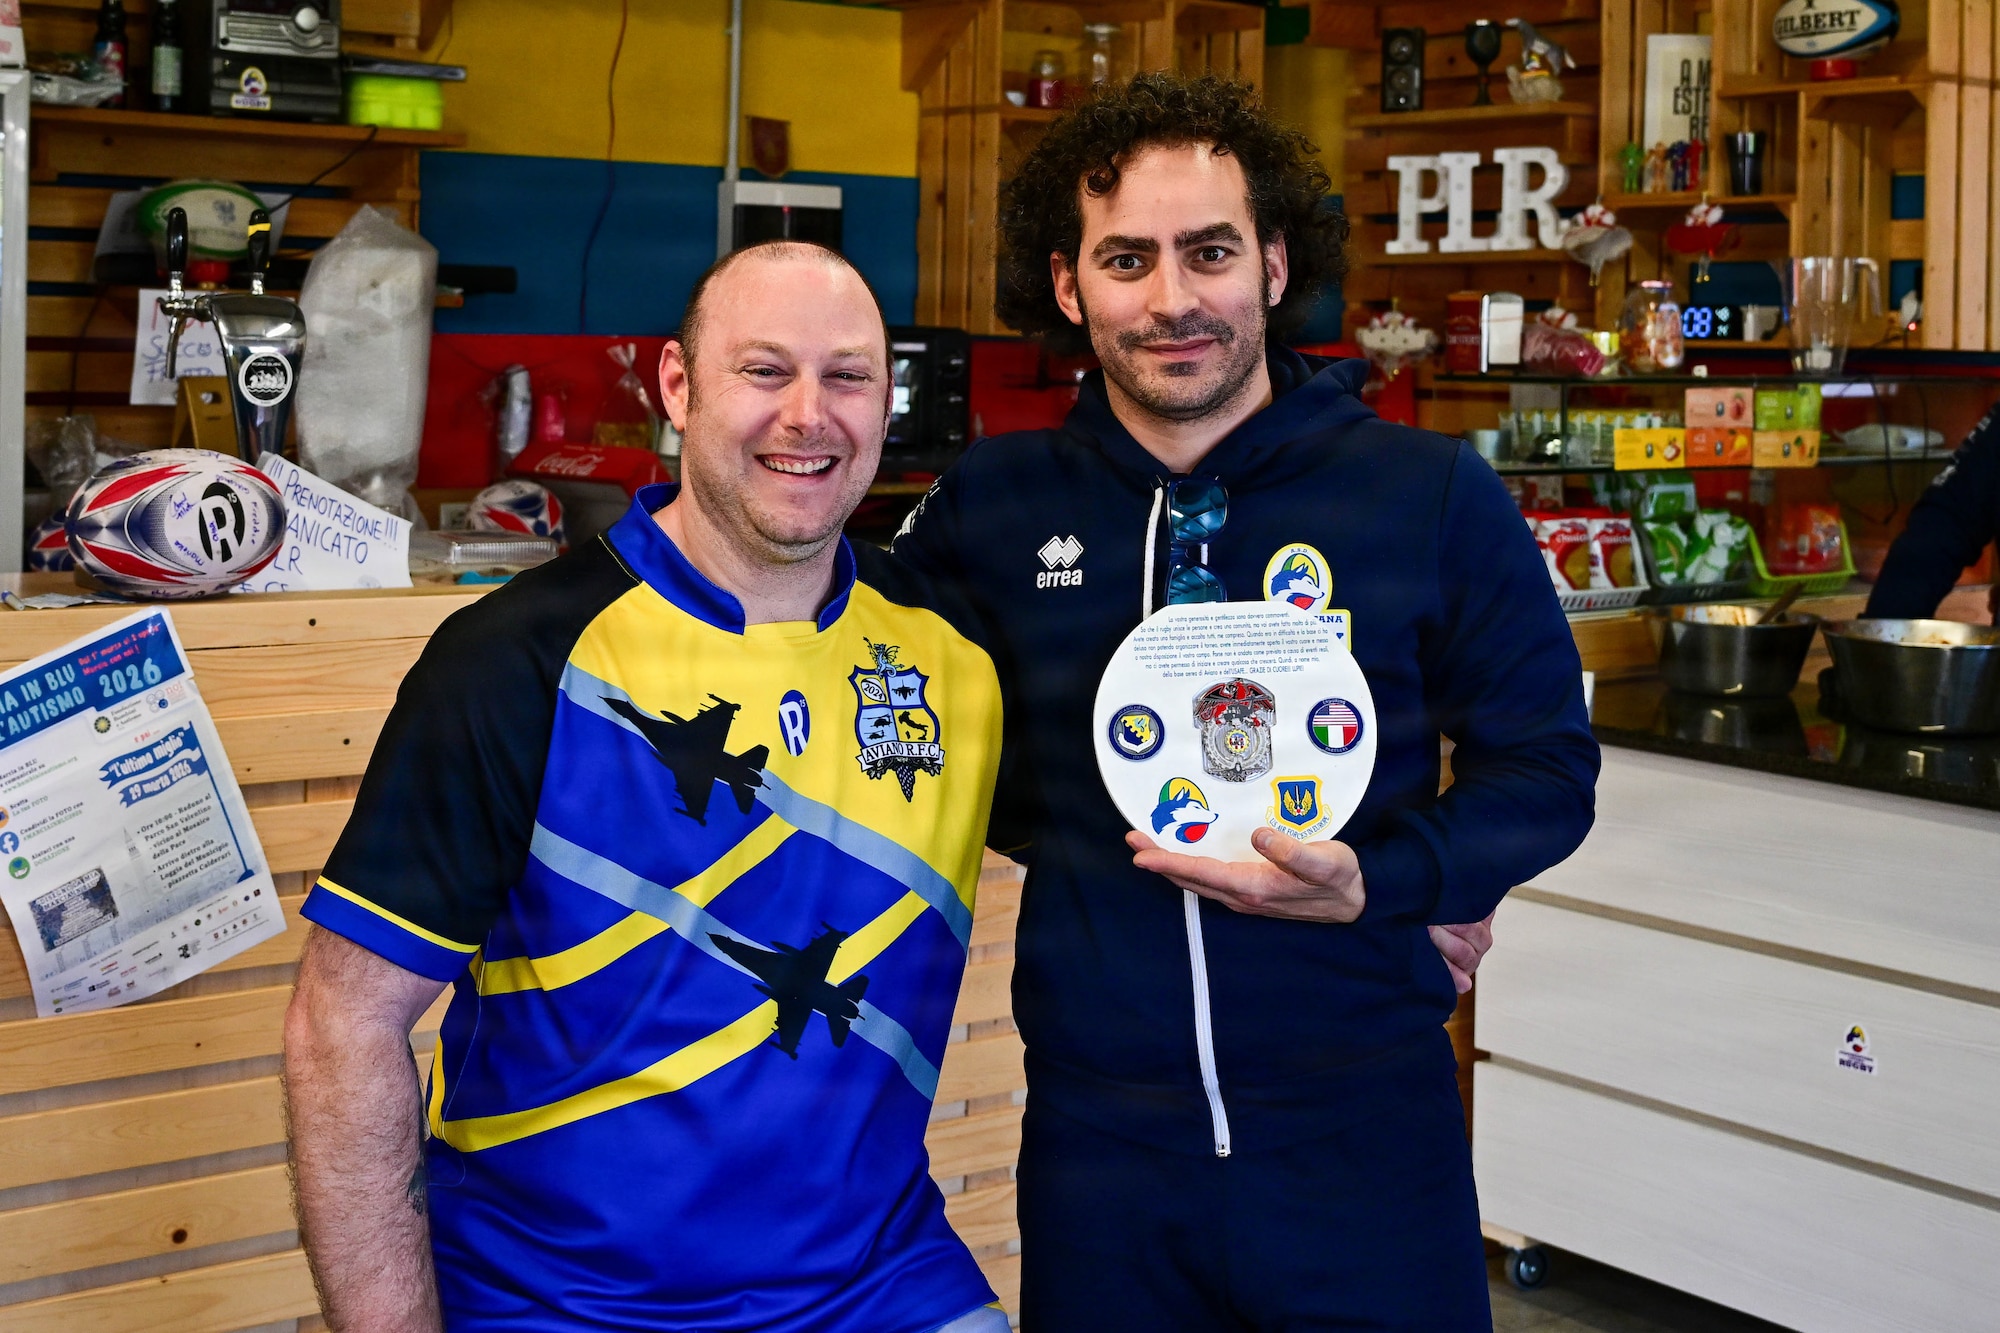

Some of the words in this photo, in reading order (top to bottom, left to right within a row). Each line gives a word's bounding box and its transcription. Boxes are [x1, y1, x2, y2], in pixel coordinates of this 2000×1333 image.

[1775, 10, 1861, 34] GILBERT
[1386, 146, 1568, 254] PLR
[534, 451, 606, 476] Coca-Cola
[226, 492, 238, 504] 15
[286, 508, 368, 564] ANICATO
[1036, 568, 1083, 590] errea
[20, 679, 42, 702] IN
[44, 663, 76, 691] BLU
[99, 656, 162, 698] 2026
[864, 683, 884, 700] 2024
[780, 700, 808, 756] R
[24, 758, 38, 768] BLU
[866, 742, 903, 761] AVIANO
[907, 744, 938, 757] R.F.C.
[128, 784, 143, 801] 29
[142, 776, 170, 795] marzo
[166, 761, 192, 781] 2026
[31, 795, 49, 807] FOTO
[55, 806, 73, 818] FOTO
[140, 822, 154, 833] Ore
[144, 828, 166, 842] Parco
[165, 820, 179, 831] San
[179, 804, 212, 824] Valentino
[152, 833, 174, 849] vicino
[182, 816, 210, 834] Mosaico
[1312, 816, 1330, 832] EUROPE
[151, 847, 170, 860] della
[170, 838, 187, 851] Pace
[156, 856, 180, 872] Arrivo
[179, 845, 201, 860] dietro
[201, 838, 214, 849] alla
[160, 865, 183, 882] Loggia
[183, 859, 195, 869] del
[195, 841, 229, 862] Municipio
[1838, 1058, 1874, 1074] RUGBY
